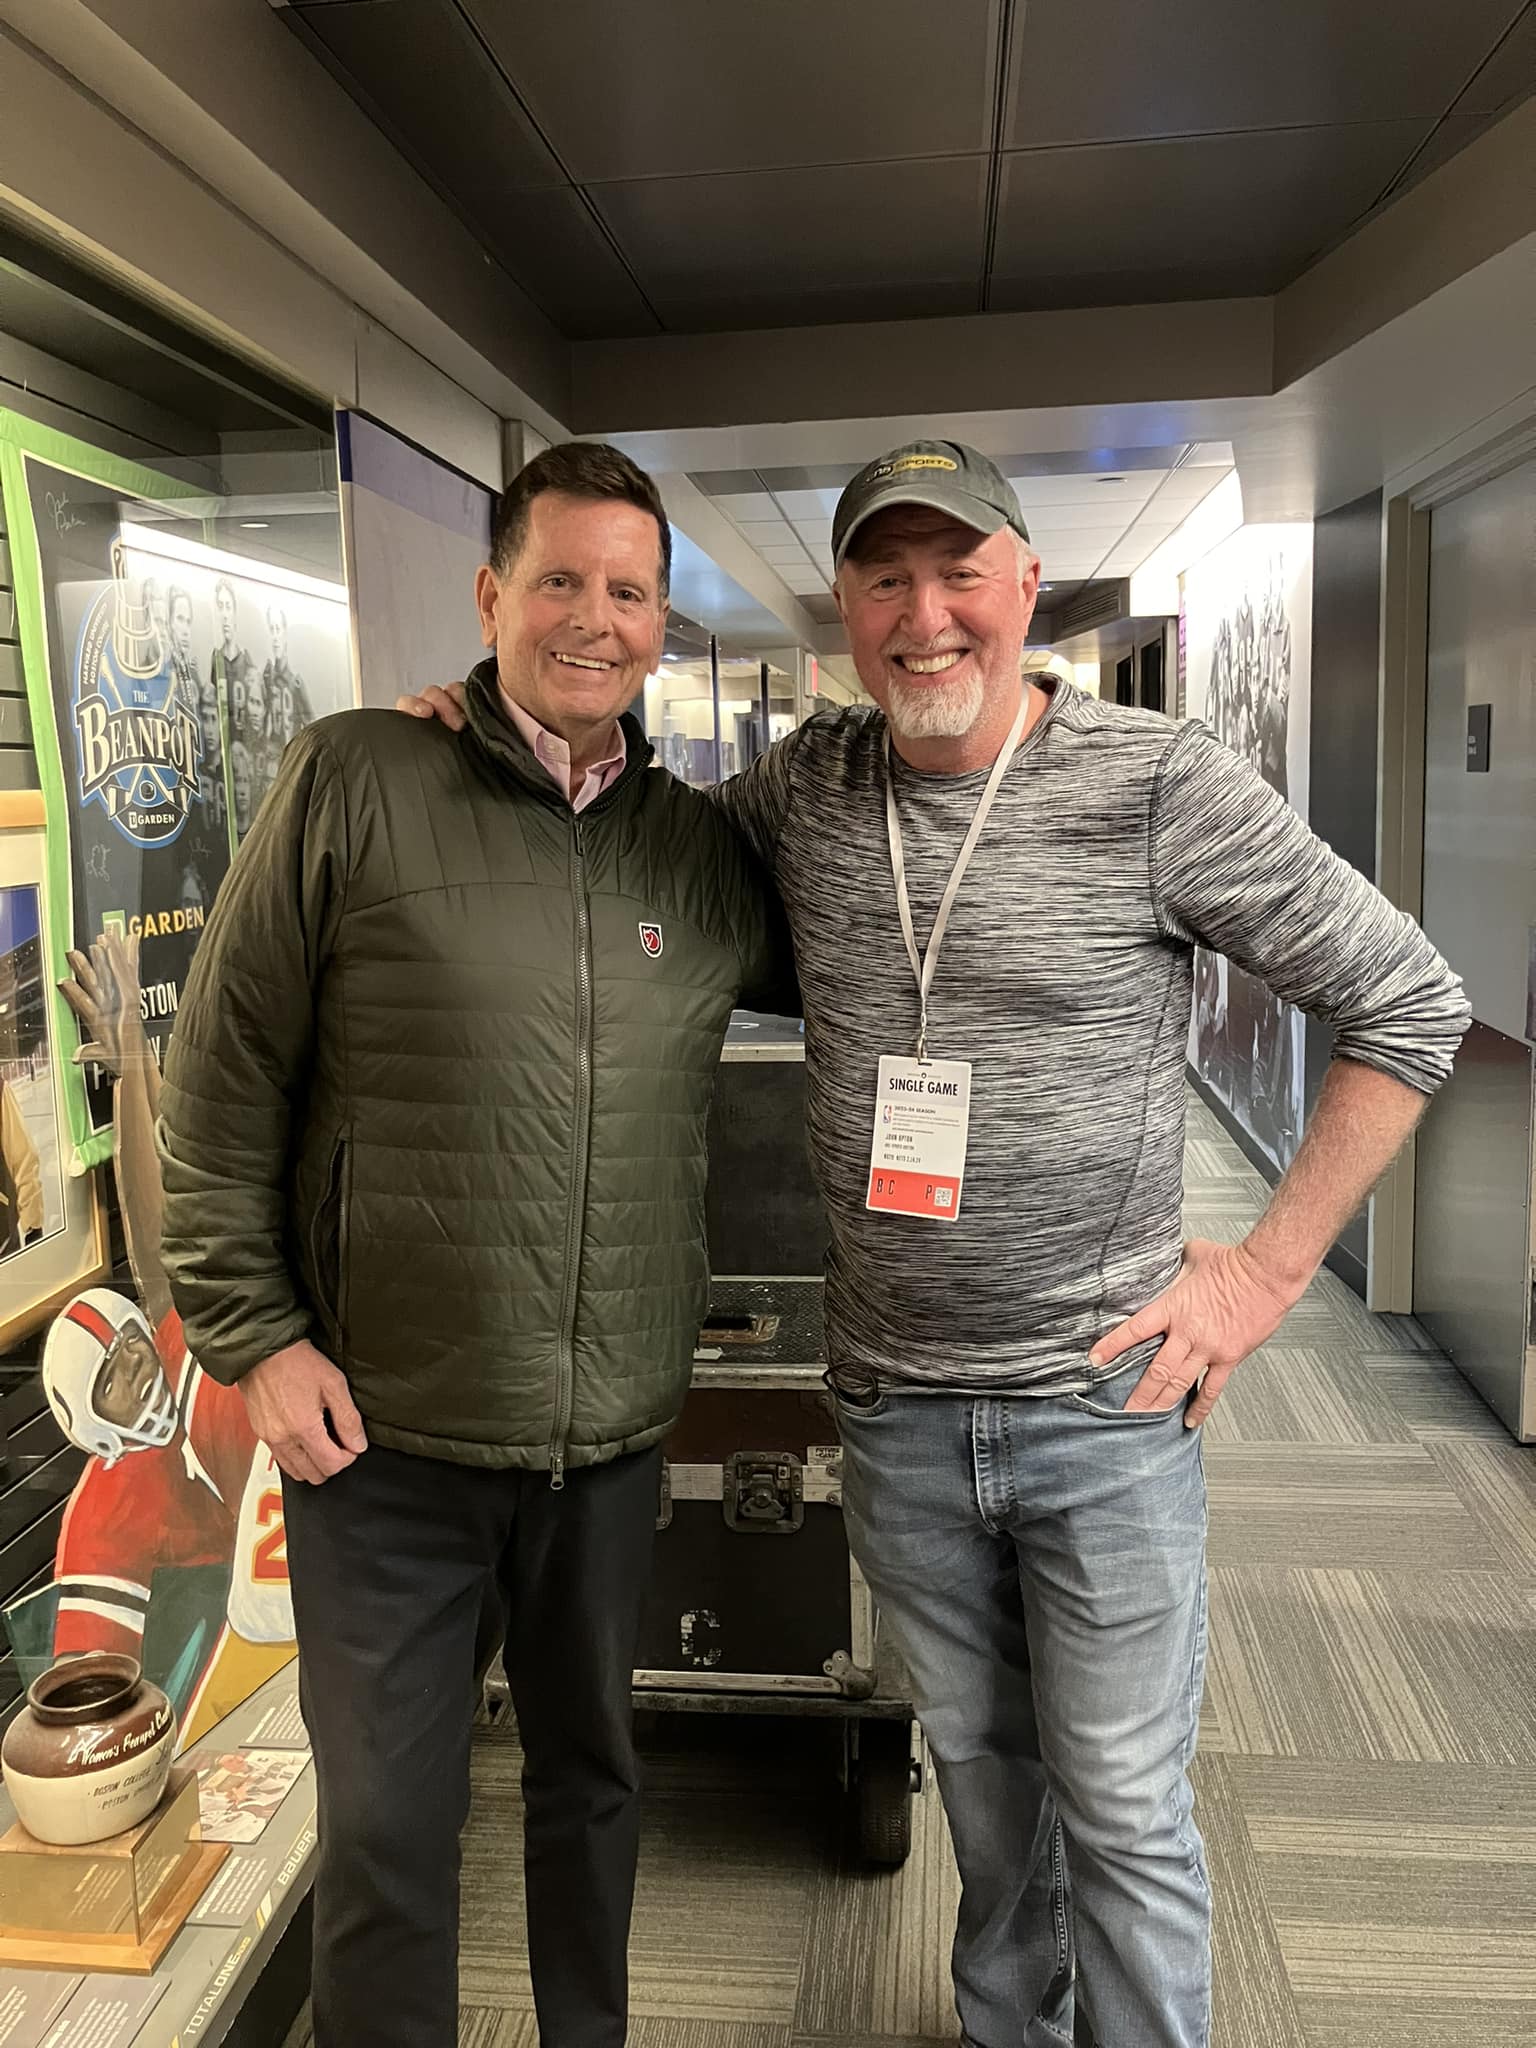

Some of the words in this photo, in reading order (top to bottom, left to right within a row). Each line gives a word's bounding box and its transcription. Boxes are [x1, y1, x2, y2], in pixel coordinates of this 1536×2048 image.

[133, 690, 149, 703] THE
[80, 702, 199, 787] BEANPOT
[138, 814, 175, 825] GARDEN
[129, 905, 205, 939] GARDEN
[889, 1077, 925, 1093] SINGLE
[927, 1081, 959, 1096] GAME
[877, 1178, 883, 1193] B
[888, 1179, 895, 1195] C
[925, 1184, 933, 1200] P
